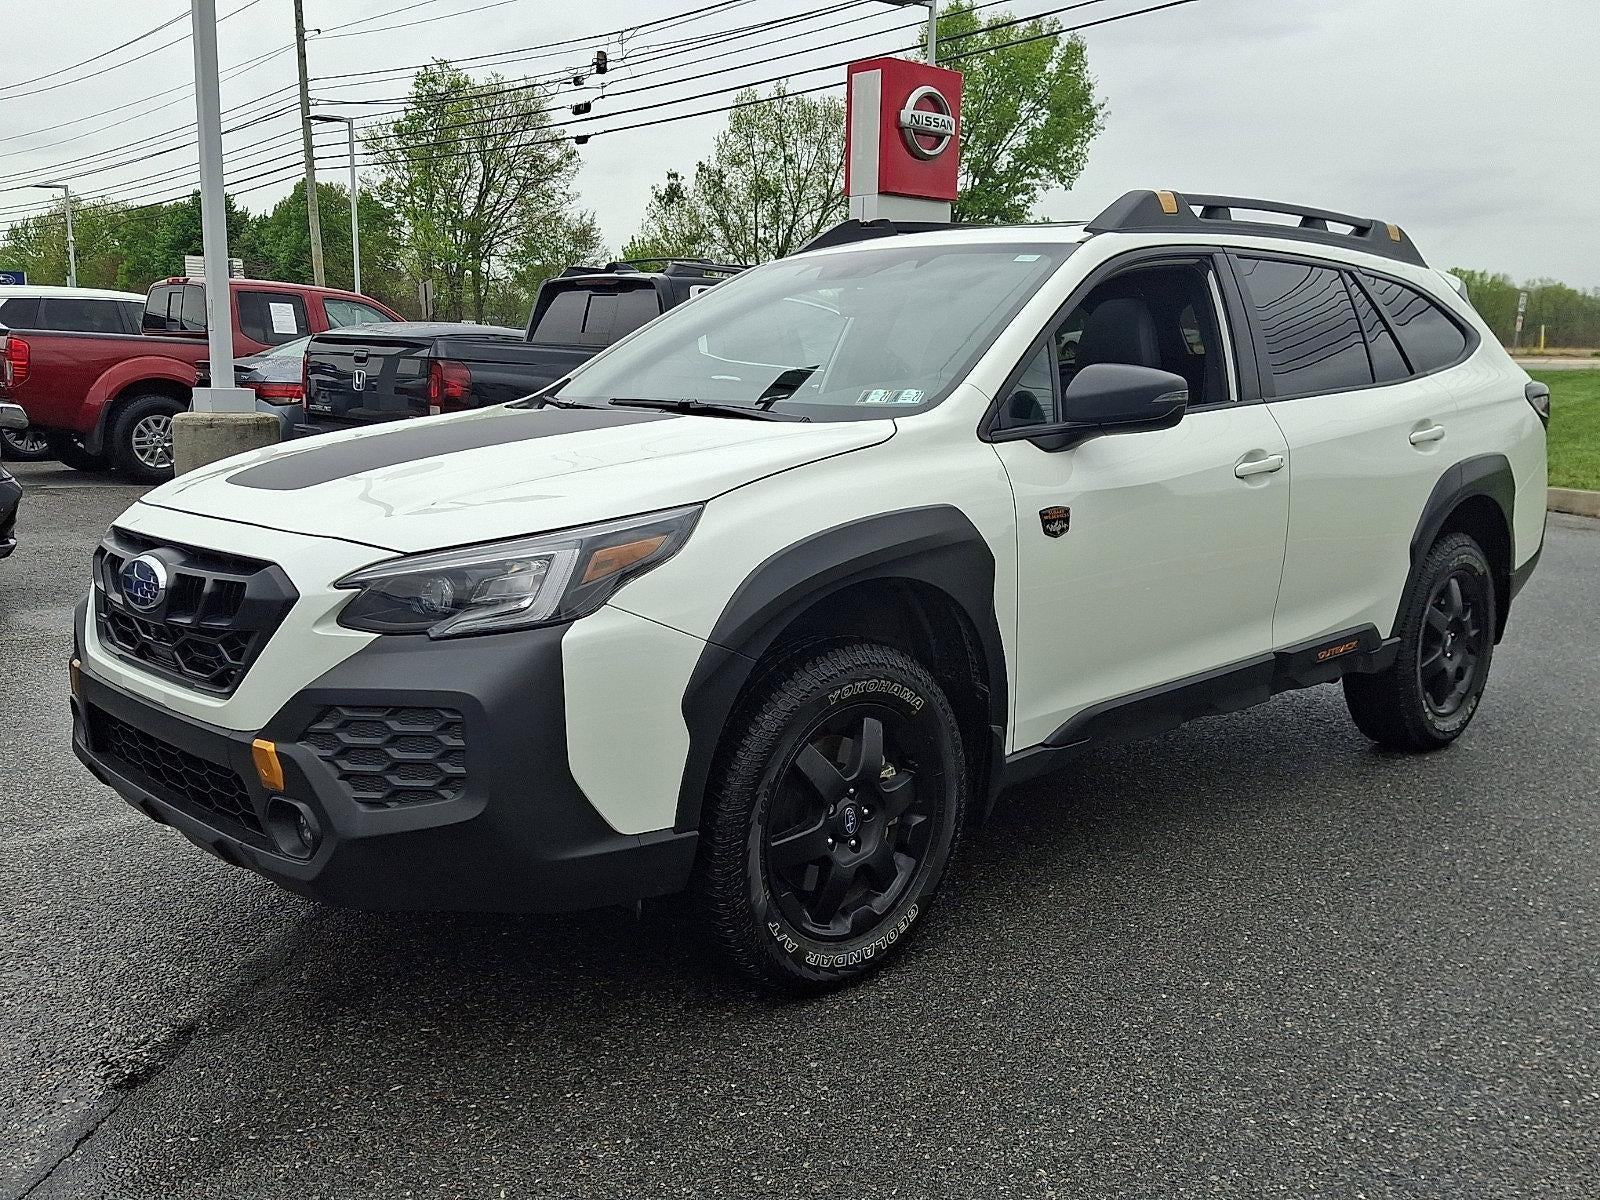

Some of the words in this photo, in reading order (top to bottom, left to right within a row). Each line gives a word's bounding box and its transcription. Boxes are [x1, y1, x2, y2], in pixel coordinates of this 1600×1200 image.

[910, 113, 953, 131] NISSAN
[828, 679, 924, 710] YOKOHAMA
[768, 922, 798, 953] A/T
[806, 904, 919, 967] GEOLANDAR
